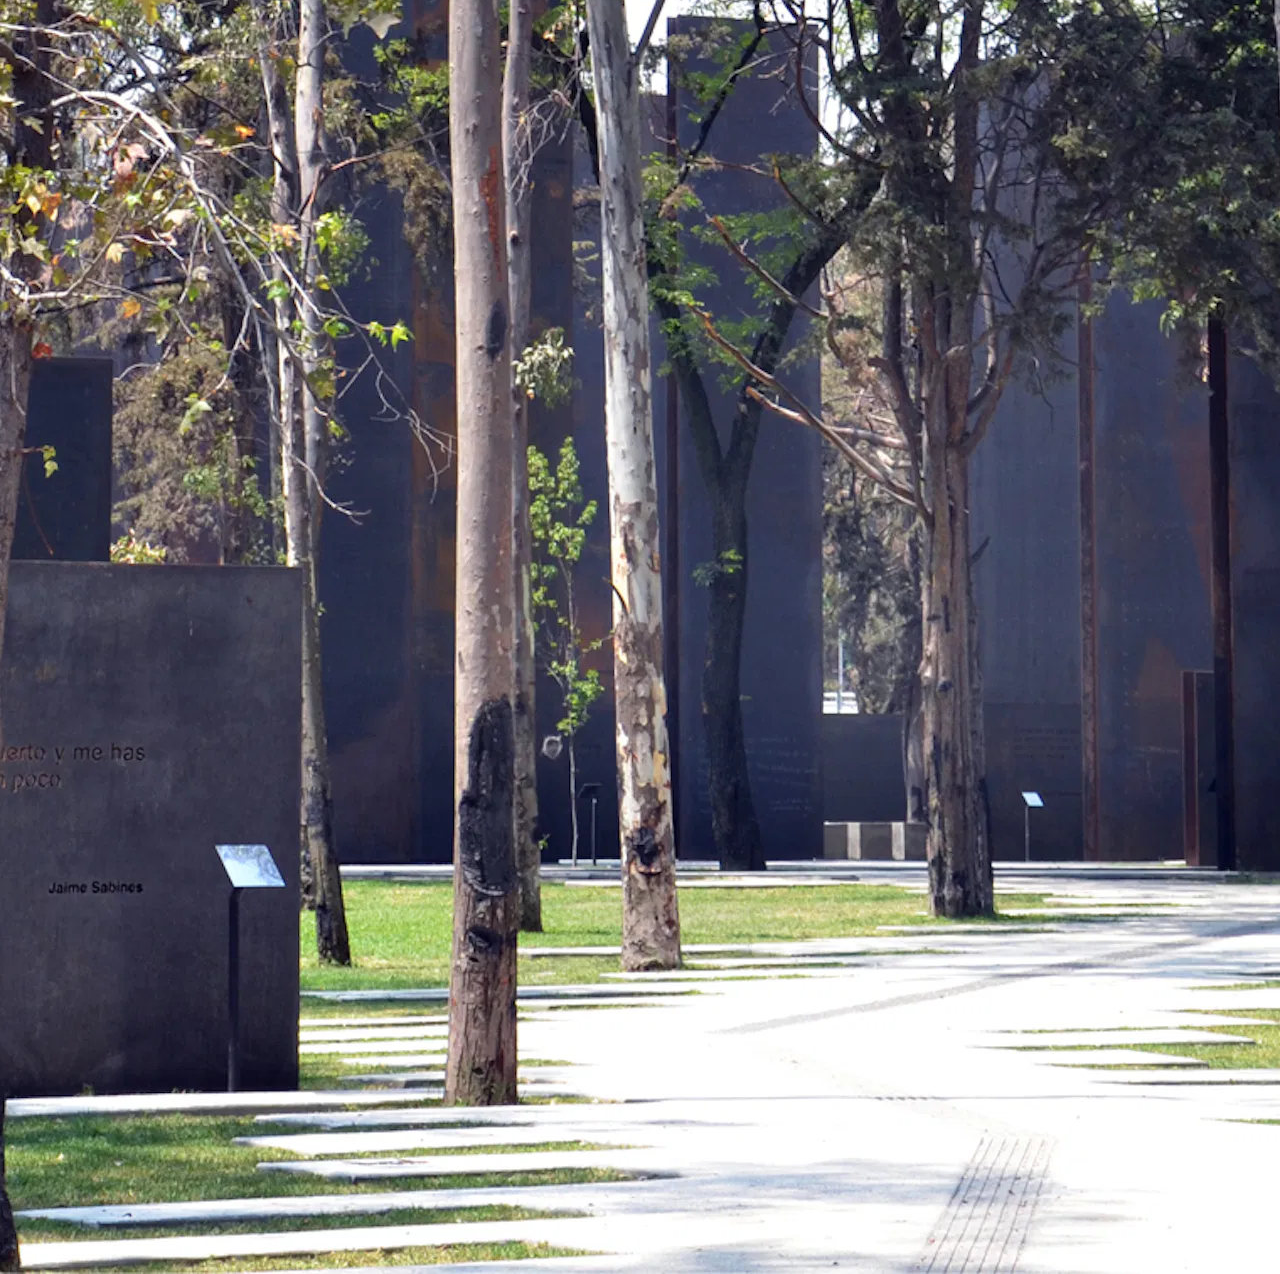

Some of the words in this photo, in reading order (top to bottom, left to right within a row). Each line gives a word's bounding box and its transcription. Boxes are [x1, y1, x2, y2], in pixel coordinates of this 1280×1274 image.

[54, 746, 64, 766] y
[73, 745, 104, 762] me
[110, 742, 146, 762] has
[48, 881, 88, 895] Jaime
[91, 880, 144, 895] Sabines
